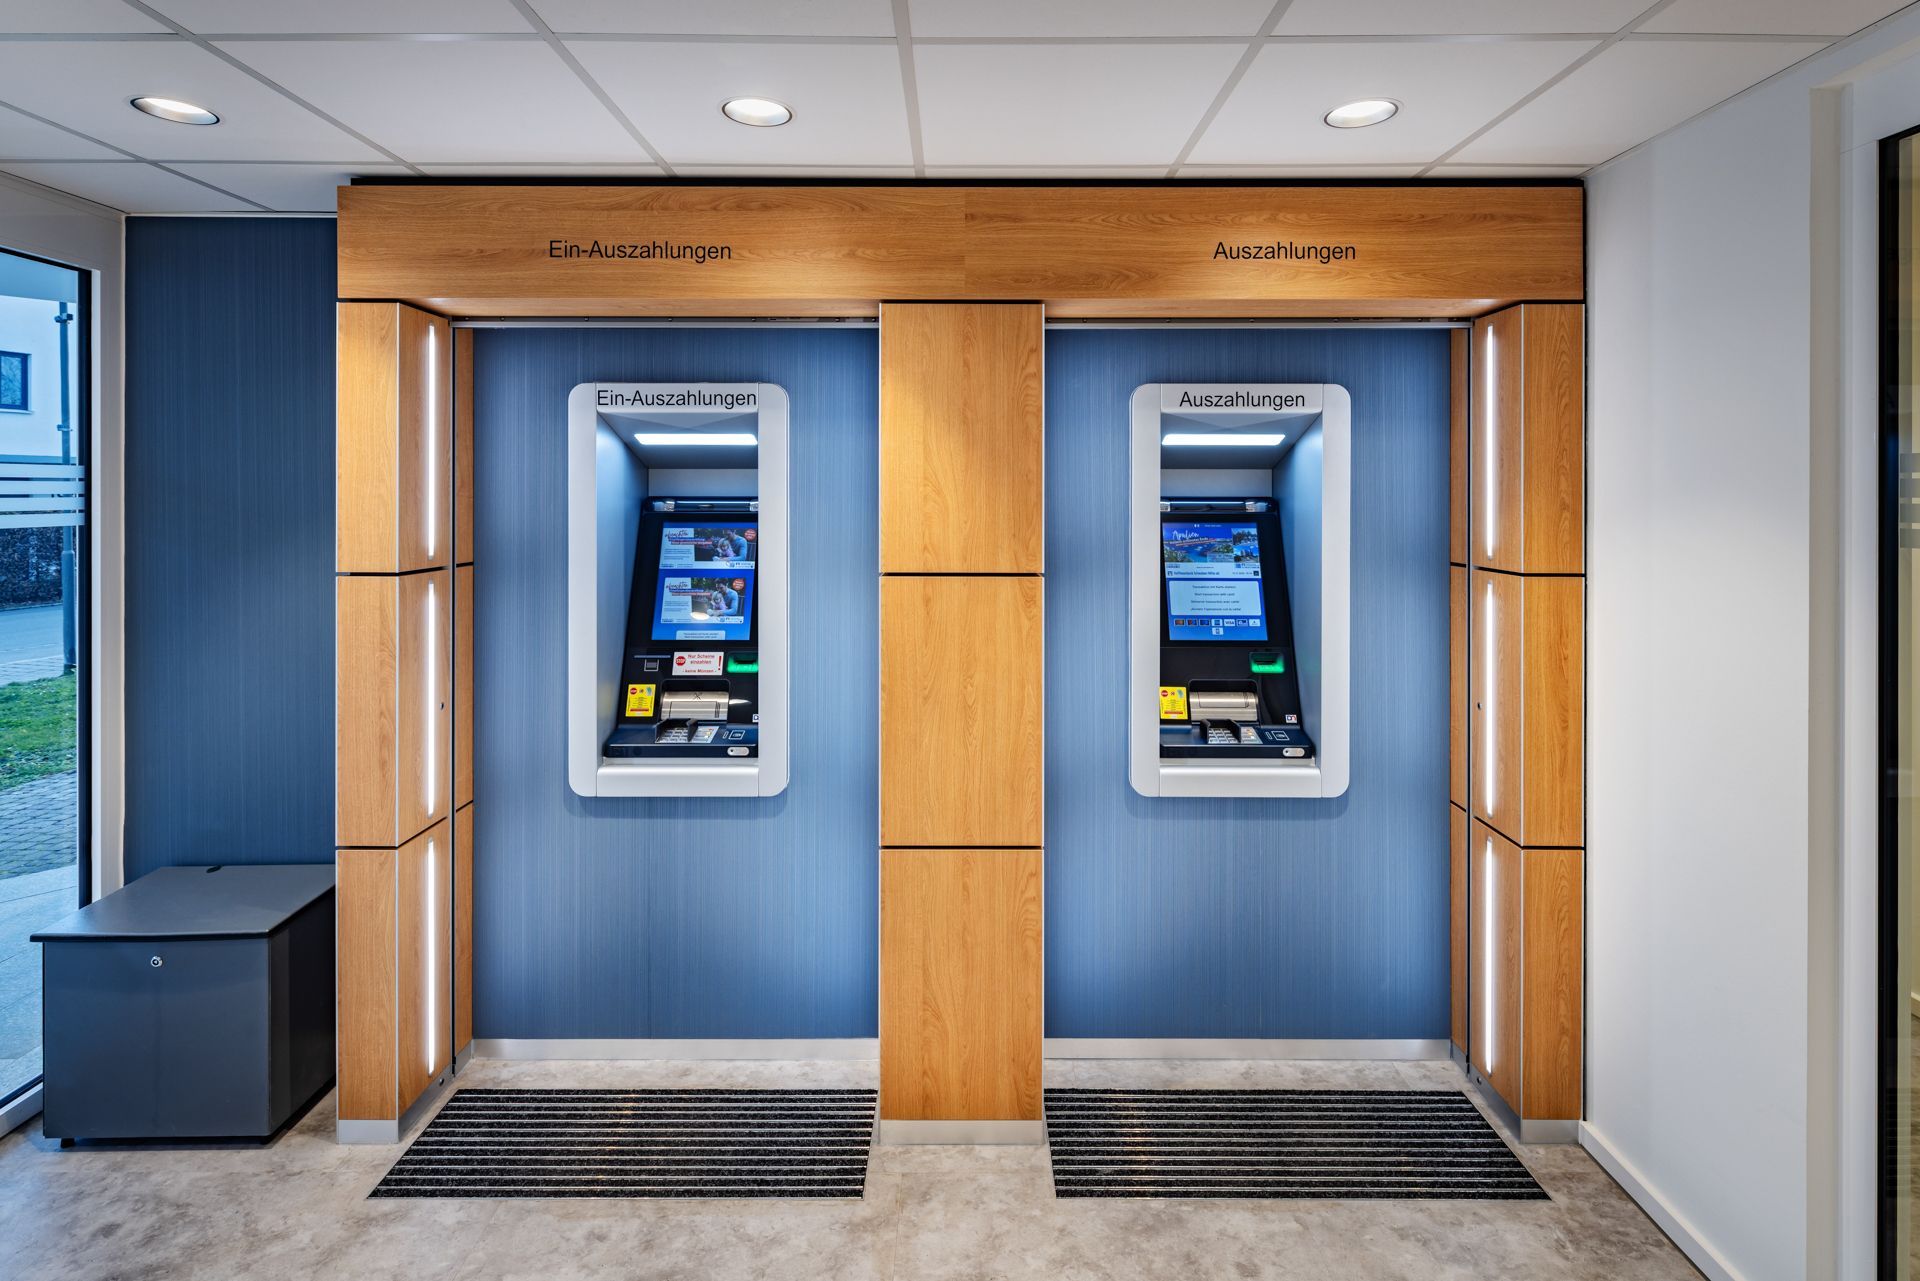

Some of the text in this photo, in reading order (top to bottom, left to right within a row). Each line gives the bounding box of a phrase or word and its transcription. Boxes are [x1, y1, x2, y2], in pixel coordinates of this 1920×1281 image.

[549, 240, 731, 263] Ein-Auszahlungen
[1213, 242, 1356, 264] Auszahlungen
[597, 390, 757, 409] Ein-Auszahlungen
[1179, 391, 1305, 411] Auszahlungen
